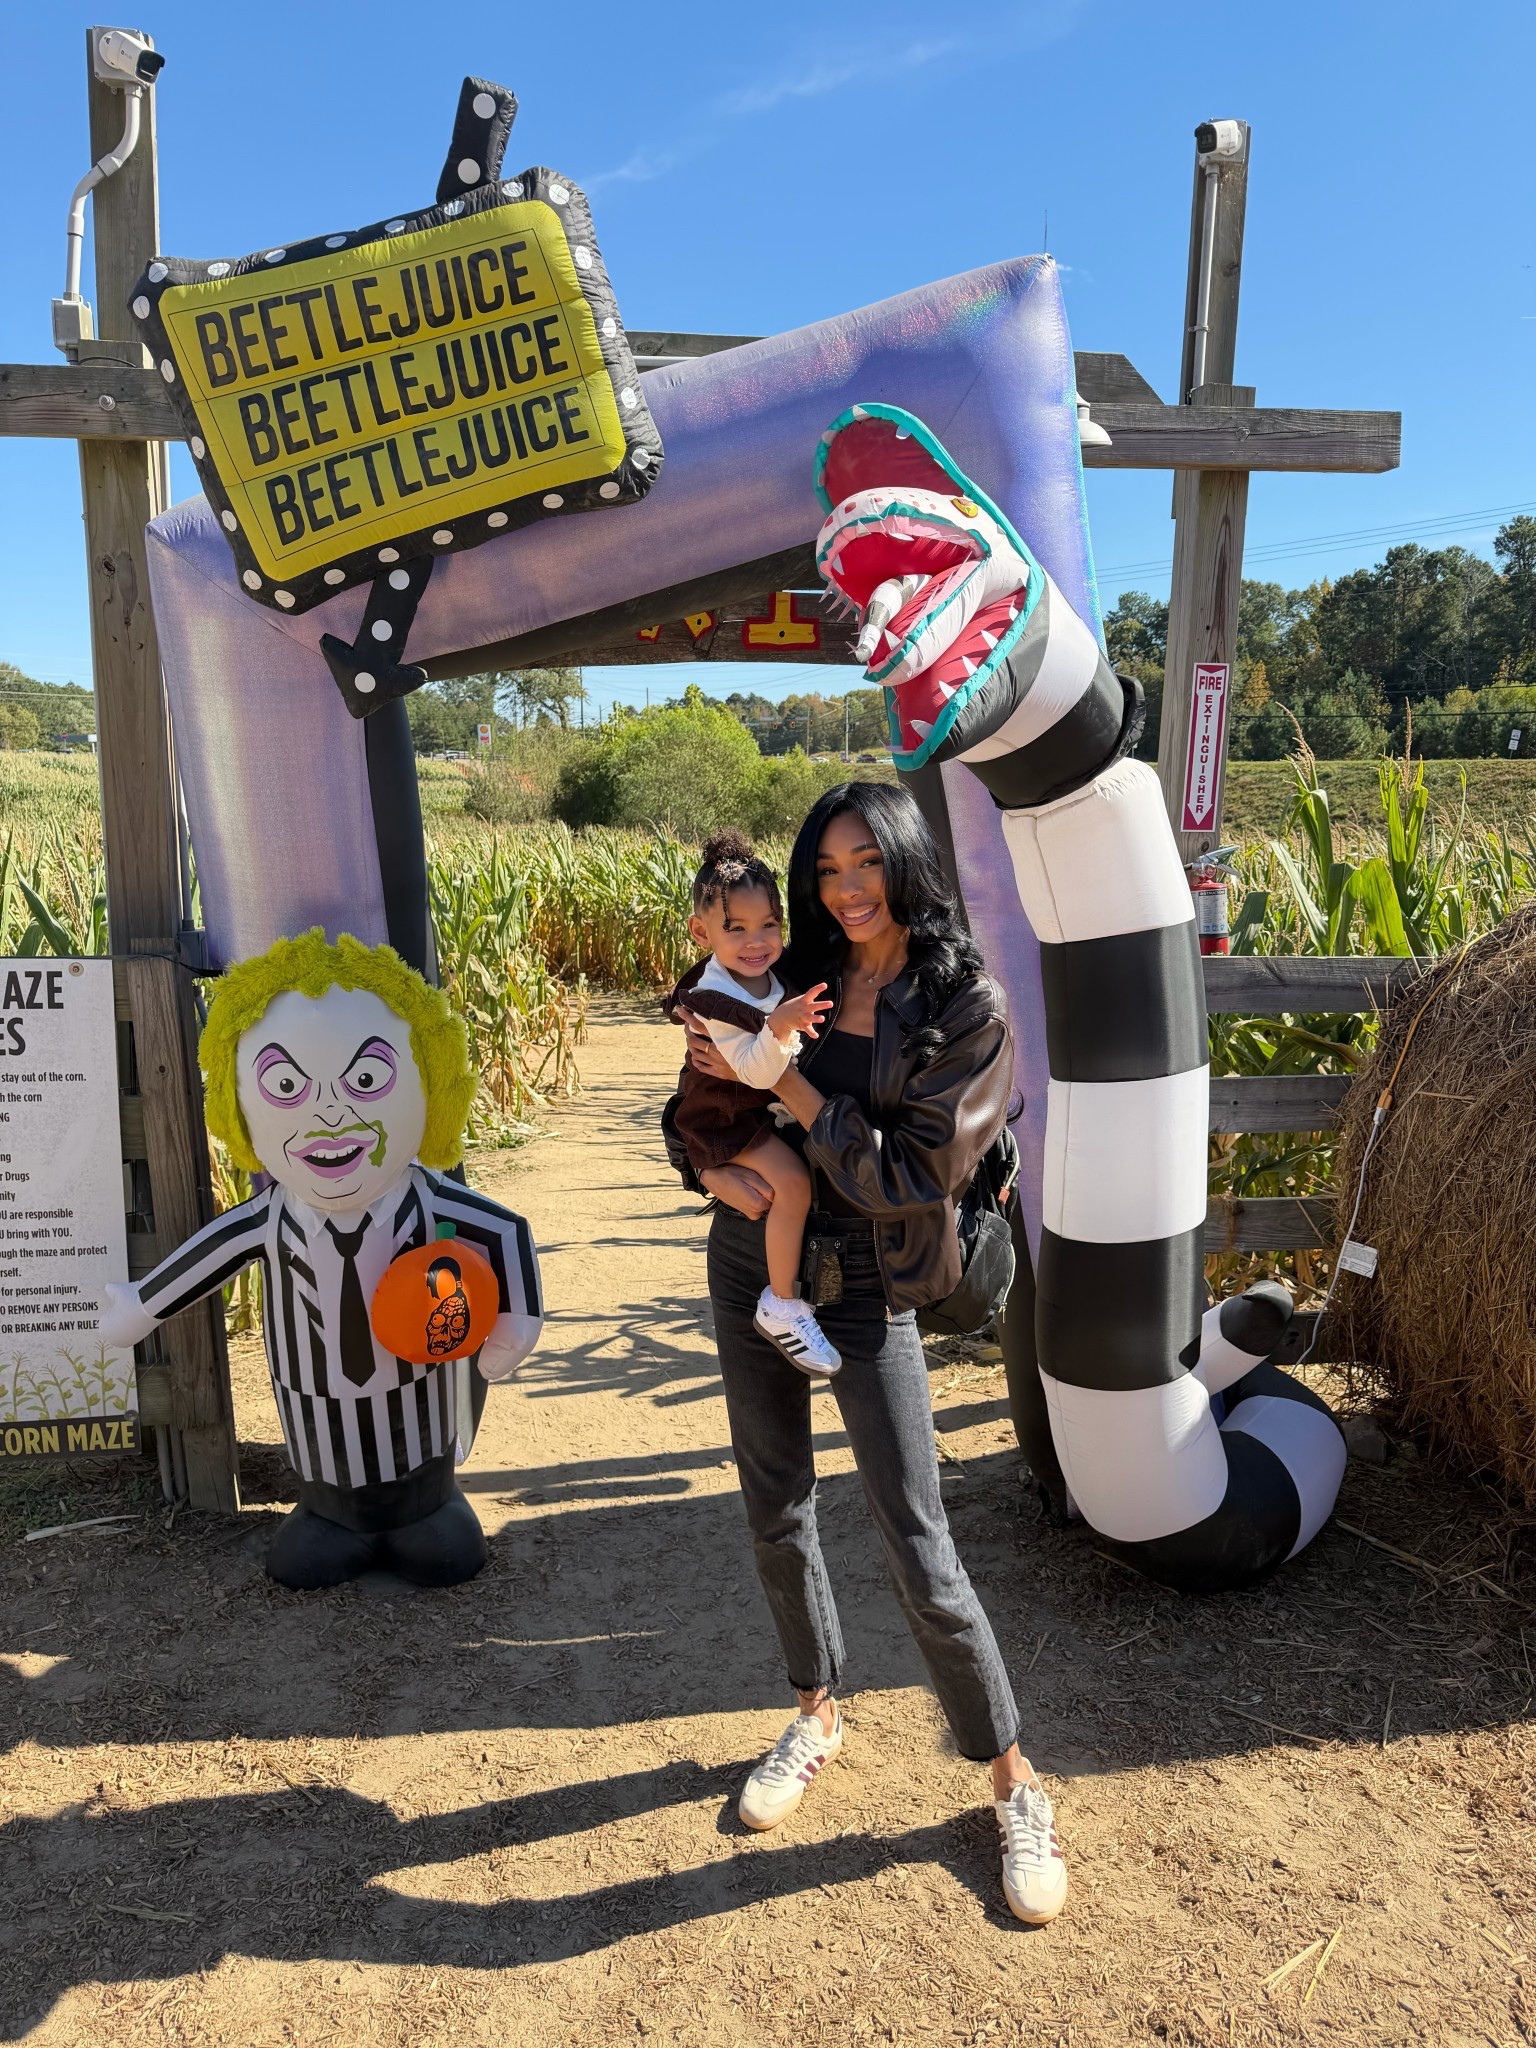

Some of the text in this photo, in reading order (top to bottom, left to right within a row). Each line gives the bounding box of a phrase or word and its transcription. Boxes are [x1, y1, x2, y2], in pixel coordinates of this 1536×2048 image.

[195, 241, 536, 388] BEETLEJUICE
[238, 314, 569, 467] BEETLEJUICE
[265, 387, 590, 547] BEETLEJUICE
[1199, 676, 1223, 690] FIRE
[1195, 695, 1214, 814] EXTINGUISHER
[1, 1072, 86, 1084] stay out of the corn.
[7, 1092, 21, 1102] the
[23, 1094, 42, 1102] corn
[5, 1171, 30, 1182] Drugs
[25, 1209, 73, 1220] responsible
[7, 1229, 29, 1240] bring
[31, 1228, 50, 1238] with
[52, 1227, 72, 1238] YOU.
[0, 1245, 107, 1259] ugh the maze and protect
[1, 1284, 81, 1297] for personal injury.
[8, 1303, 41, 1315] REMOVE
[43, 1303, 60, 1313] ANY
[62, 1301, 99, 1312] PERSONS
[1, 1319, 100, 1333] OR BREAKING ANY RULE
[66, 1420, 136, 1452] MAZE
